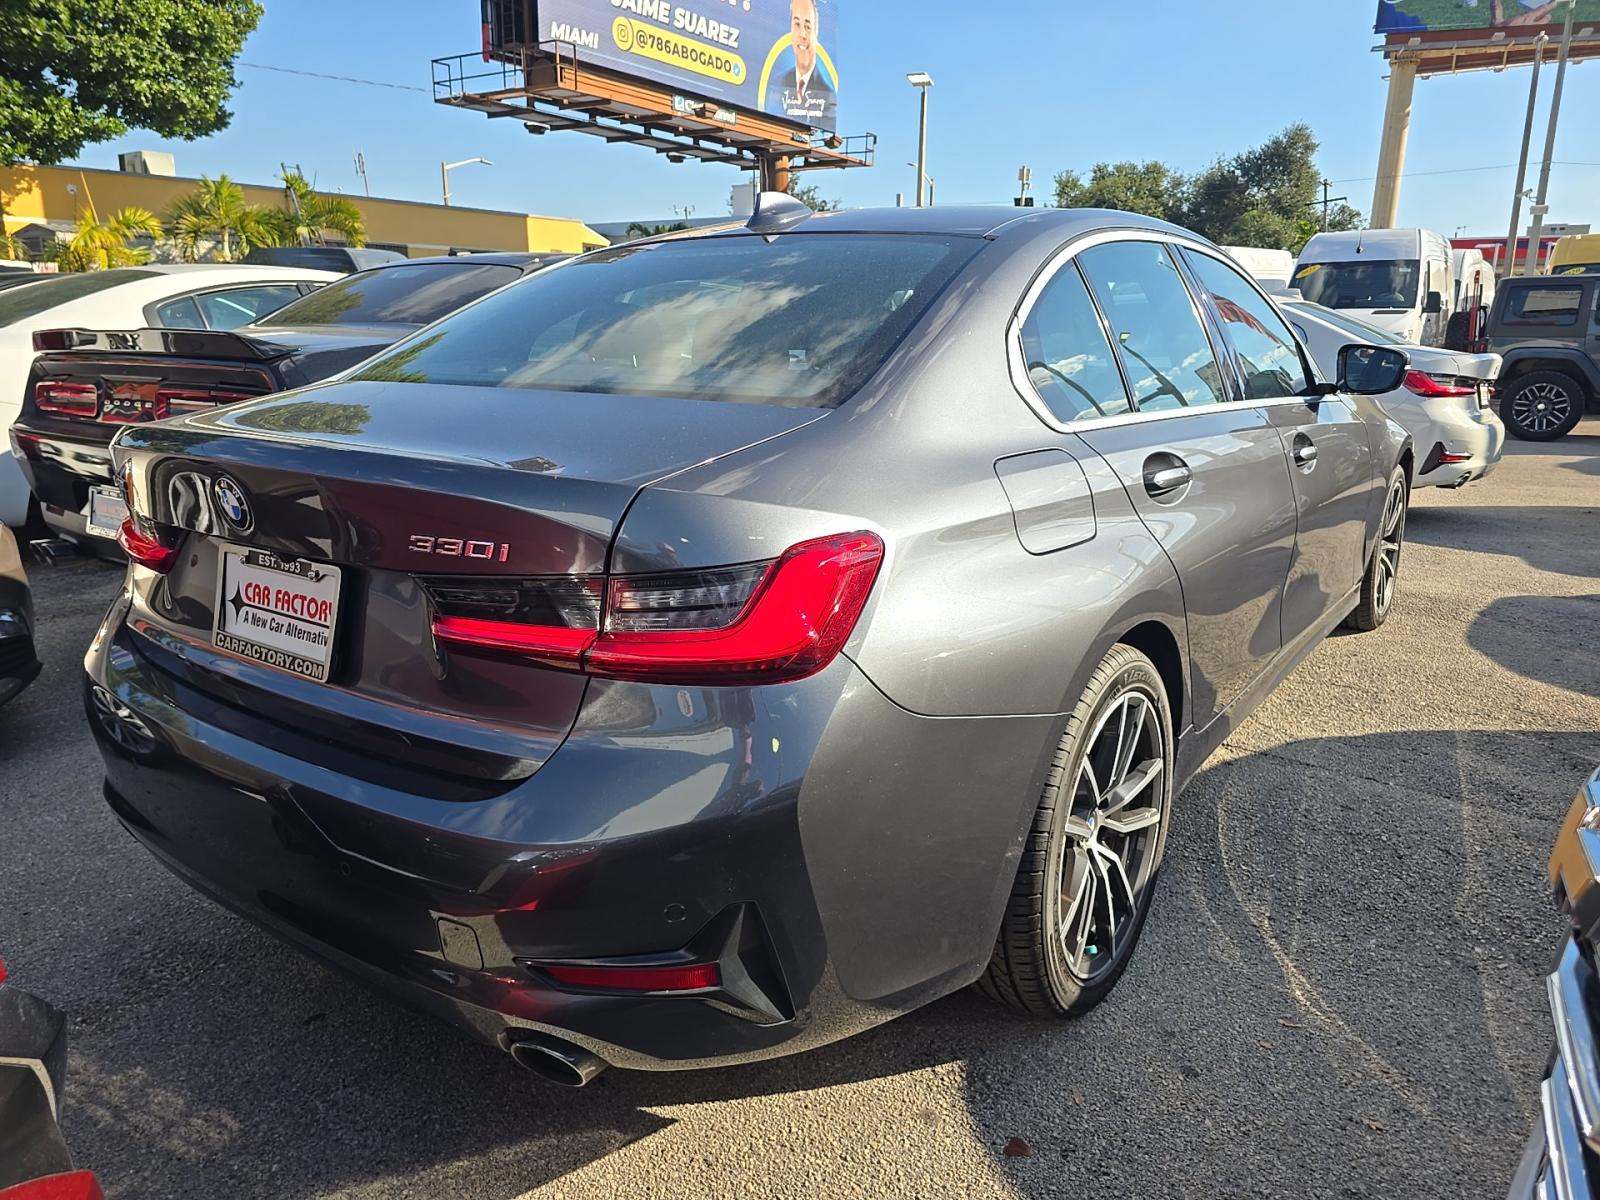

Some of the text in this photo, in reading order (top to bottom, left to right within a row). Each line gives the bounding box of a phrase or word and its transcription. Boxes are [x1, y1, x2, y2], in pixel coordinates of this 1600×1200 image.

[550, 21, 600, 49] MIAMI
[673, 8, 741, 48] SUAREZ
[636, 29, 732, 73] @786ABOGADO
[258, 554, 301, 573] EST. 1993
[244, 582, 271, 607] CAR
[243, 610, 249, 623] A
[250, 612, 267, 629] New
[269, 617, 284, 635] Car
[216, 633, 324, 679] CARFACTORY.COM
